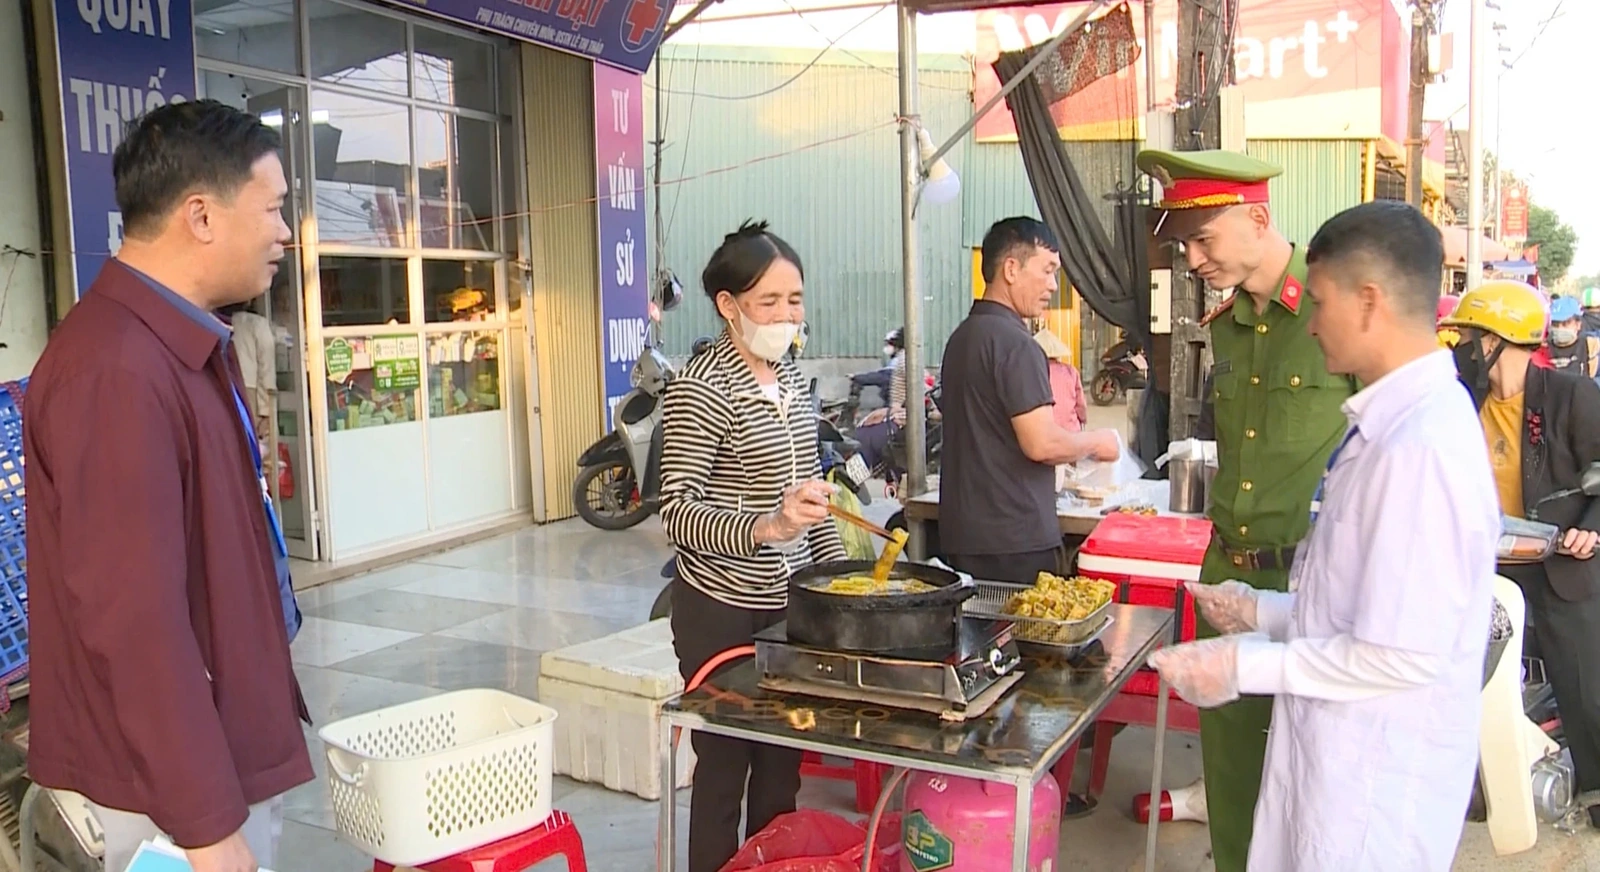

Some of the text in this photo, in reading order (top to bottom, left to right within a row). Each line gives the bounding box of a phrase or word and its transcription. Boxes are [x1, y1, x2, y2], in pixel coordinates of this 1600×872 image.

[611, 88, 629, 135] TƯ
[608, 152, 636, 211] VẤN
[615, 228, 635, 287] SỬ
[608, 317, 645, 373] DỤNG
